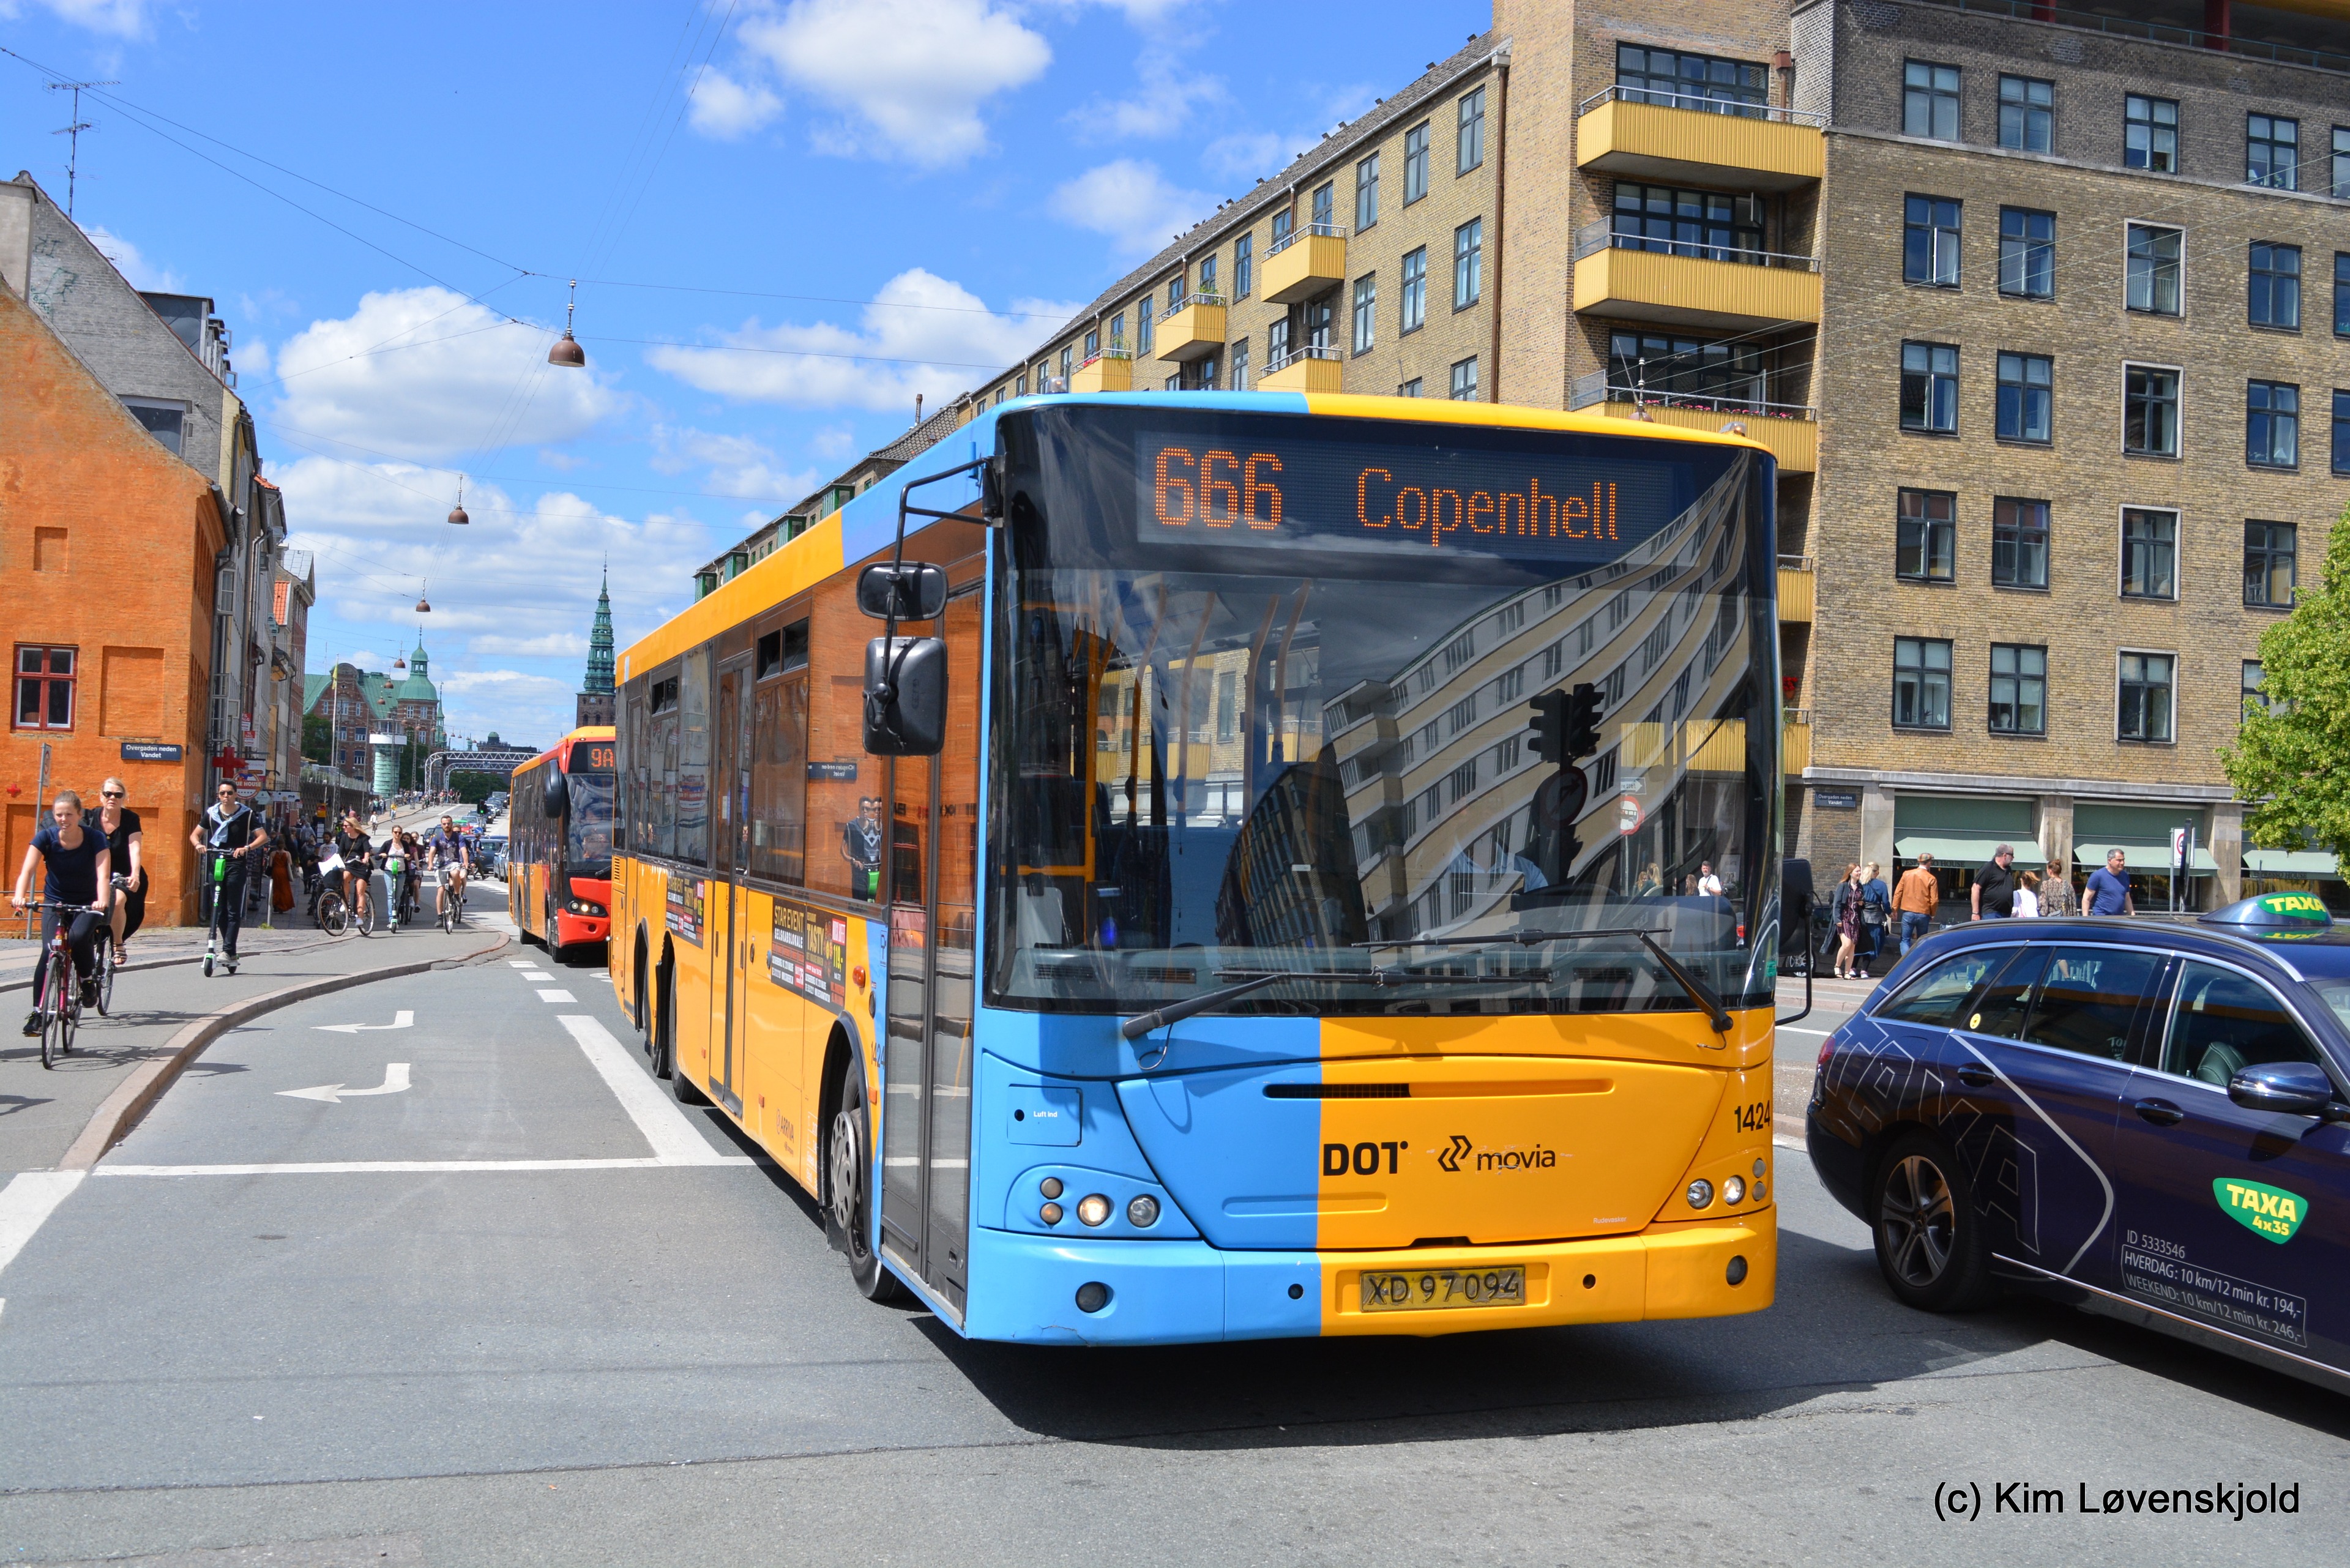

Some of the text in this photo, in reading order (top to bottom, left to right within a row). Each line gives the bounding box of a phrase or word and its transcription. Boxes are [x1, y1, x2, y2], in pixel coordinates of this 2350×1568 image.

[1155, 448, 1619, 547] 666 Copenhell
[591, 748, 614, 767] 9A
[774, 905, 787, 928] STAR
[787, 908, 804, 933] EVENT
[2265, 896, 2326, 913] TAXA
[774, 927, 803, 949] SELSKABSLOKALE
[807, 923, 824, 955] TASTY
[870, 1040, 886, 1070] 1424
[1734, 1099, 1770, 1133] 1424
[1323, 1141, 1409, 1176] DOT
[1477, 1144, 1556, 1171] movia
[2226, 1184, 2297, 1222] TAXA
[2252, 1215, 2290, 1236] 4x35
[2127, 1229, 2185, 1259] ID 5333546
[1367, 1272, 1519, 1305] XD 97 094
[2125, 1251, 2301, 1319] HVERDAG: 10 km/12 min kr. 194,-
[2126, 1273, 2301, 1342] WEEKEND: 10 km/12 min kr. 246,-
